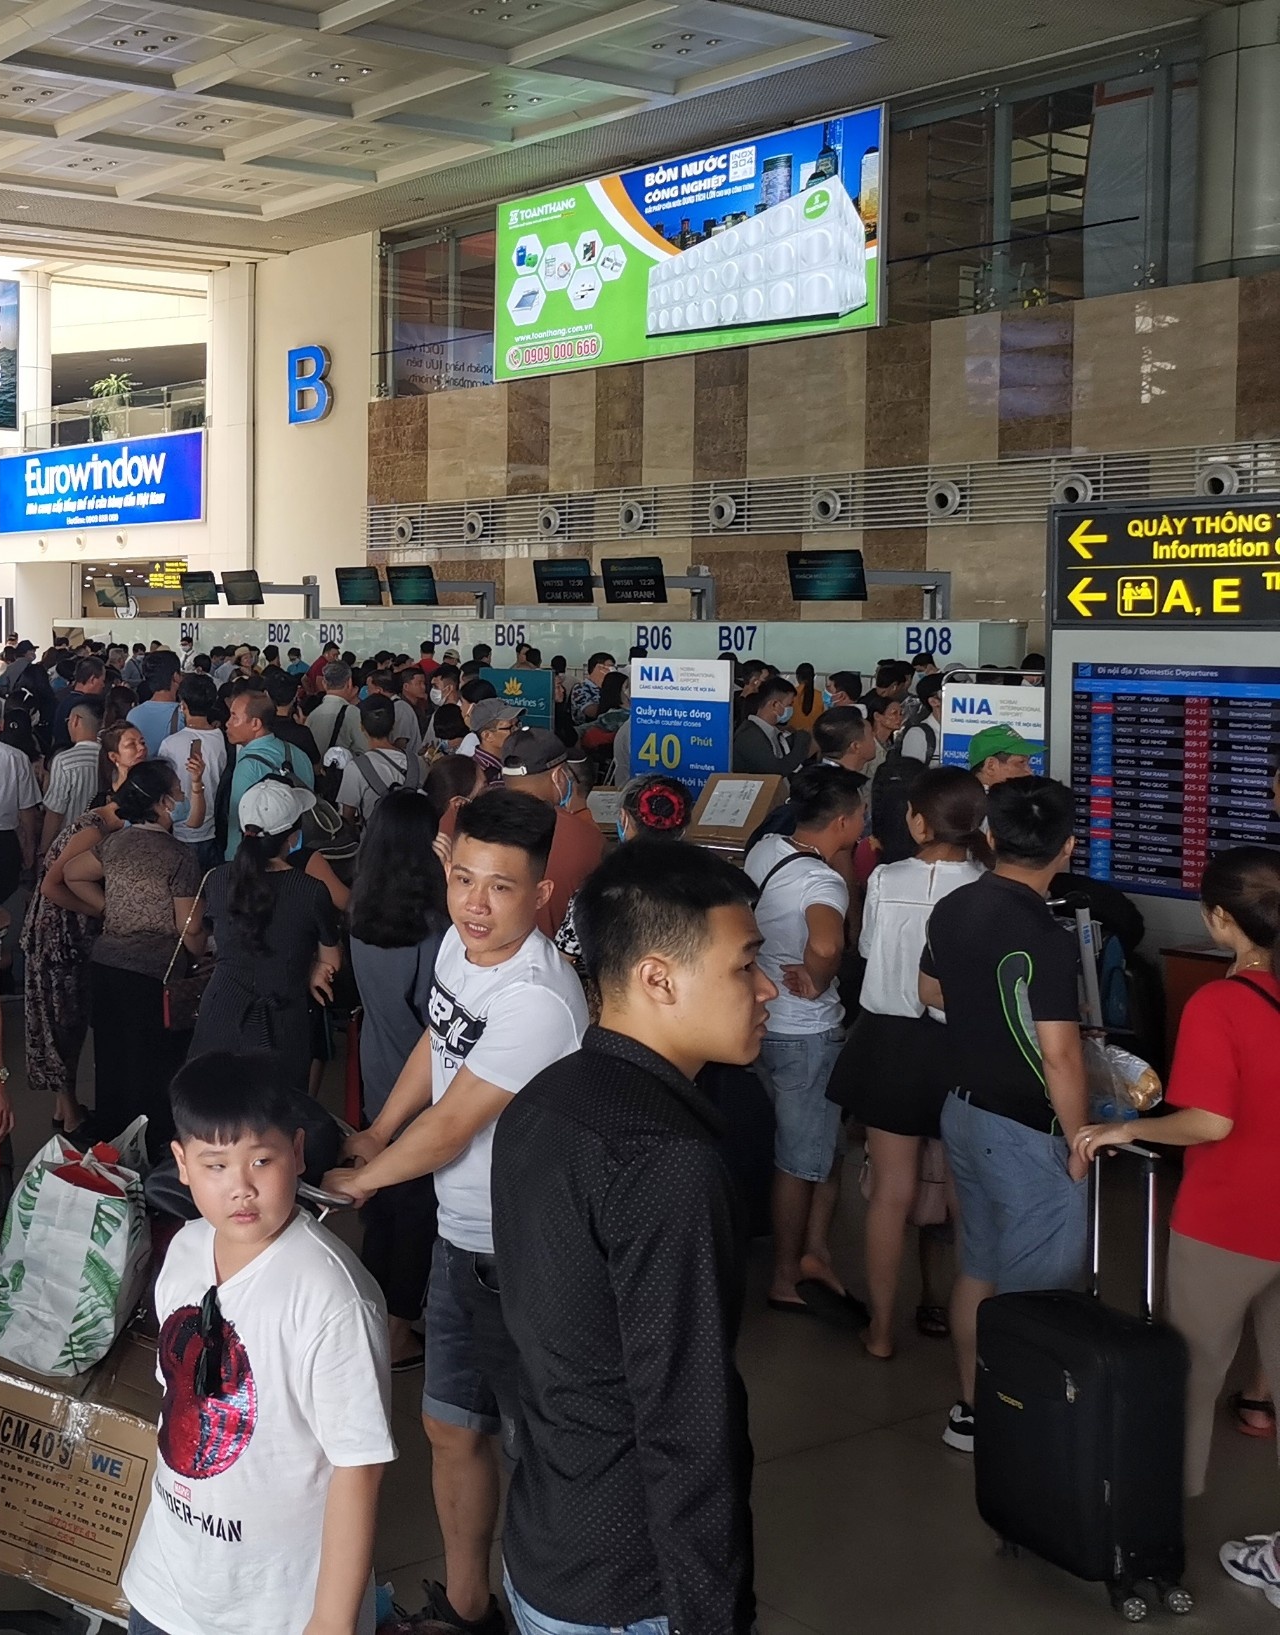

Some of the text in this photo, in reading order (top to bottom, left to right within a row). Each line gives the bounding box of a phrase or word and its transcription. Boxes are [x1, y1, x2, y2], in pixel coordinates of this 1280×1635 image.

[681, 154, 728, 179] NƯỚC
[731, 149, 754, 160] INOX
[731, 157, 754, 169] 304
[644, 186, 679, 204] CÔNG
[519, 198, 576, 220] TOANTHANG
[524, 338, 597, 364] 0909 000 666
[287, 344, 331, 425] B
[25, 446, 166, 497] Eurowindow
[1192, 511, 1271, 535] THÔNG
[1152, 538, 1269, 560] Information
[563, 591, 584, 600] RANH
[633, 591, 655, 599] RANH
[1161, 578, 1242, 616] A, E
[180, 622, 200, 641] B01
[268, 623, 291, 643] B02
[320, 624, 344, 644] B03
[432, 624, 460, 646] B04
[495, 624, 525, 646] B05
[636, 625, 672, 650] B06
[719, 625, 757, 651] B07
[905, 626, 952, 655] B08
[640, 666, 674, 682] NIA
[1139, 667, 1174, 676] Domestic
[1175, 668, 1218, 678] Departures
[515, 698, 537, 707] Airlines
[951, 697, 993, 715] NIA
[636, 717, 660, 725] Check-in
[683, 719, 702, 727] closes
[658, 706, 673, 716] thủ
[674, 708, 688, 719] tục
[689, 708, 712, 721] đóng
[638, 732, 681, 769] 40
[690, 736, 713, 747] Phút
[689, 763, 715, 771] minutes
[91, 1451, 123, 1478] WE
[16, 1451, 55, 1473] WEIGHT
[114, 1488, 134, 1501] KGS
[95, 1508, 128, 1526] CONES
[111, 1501, 131, 1514] KGS
[96, 1566, 112, 1577] LTD
